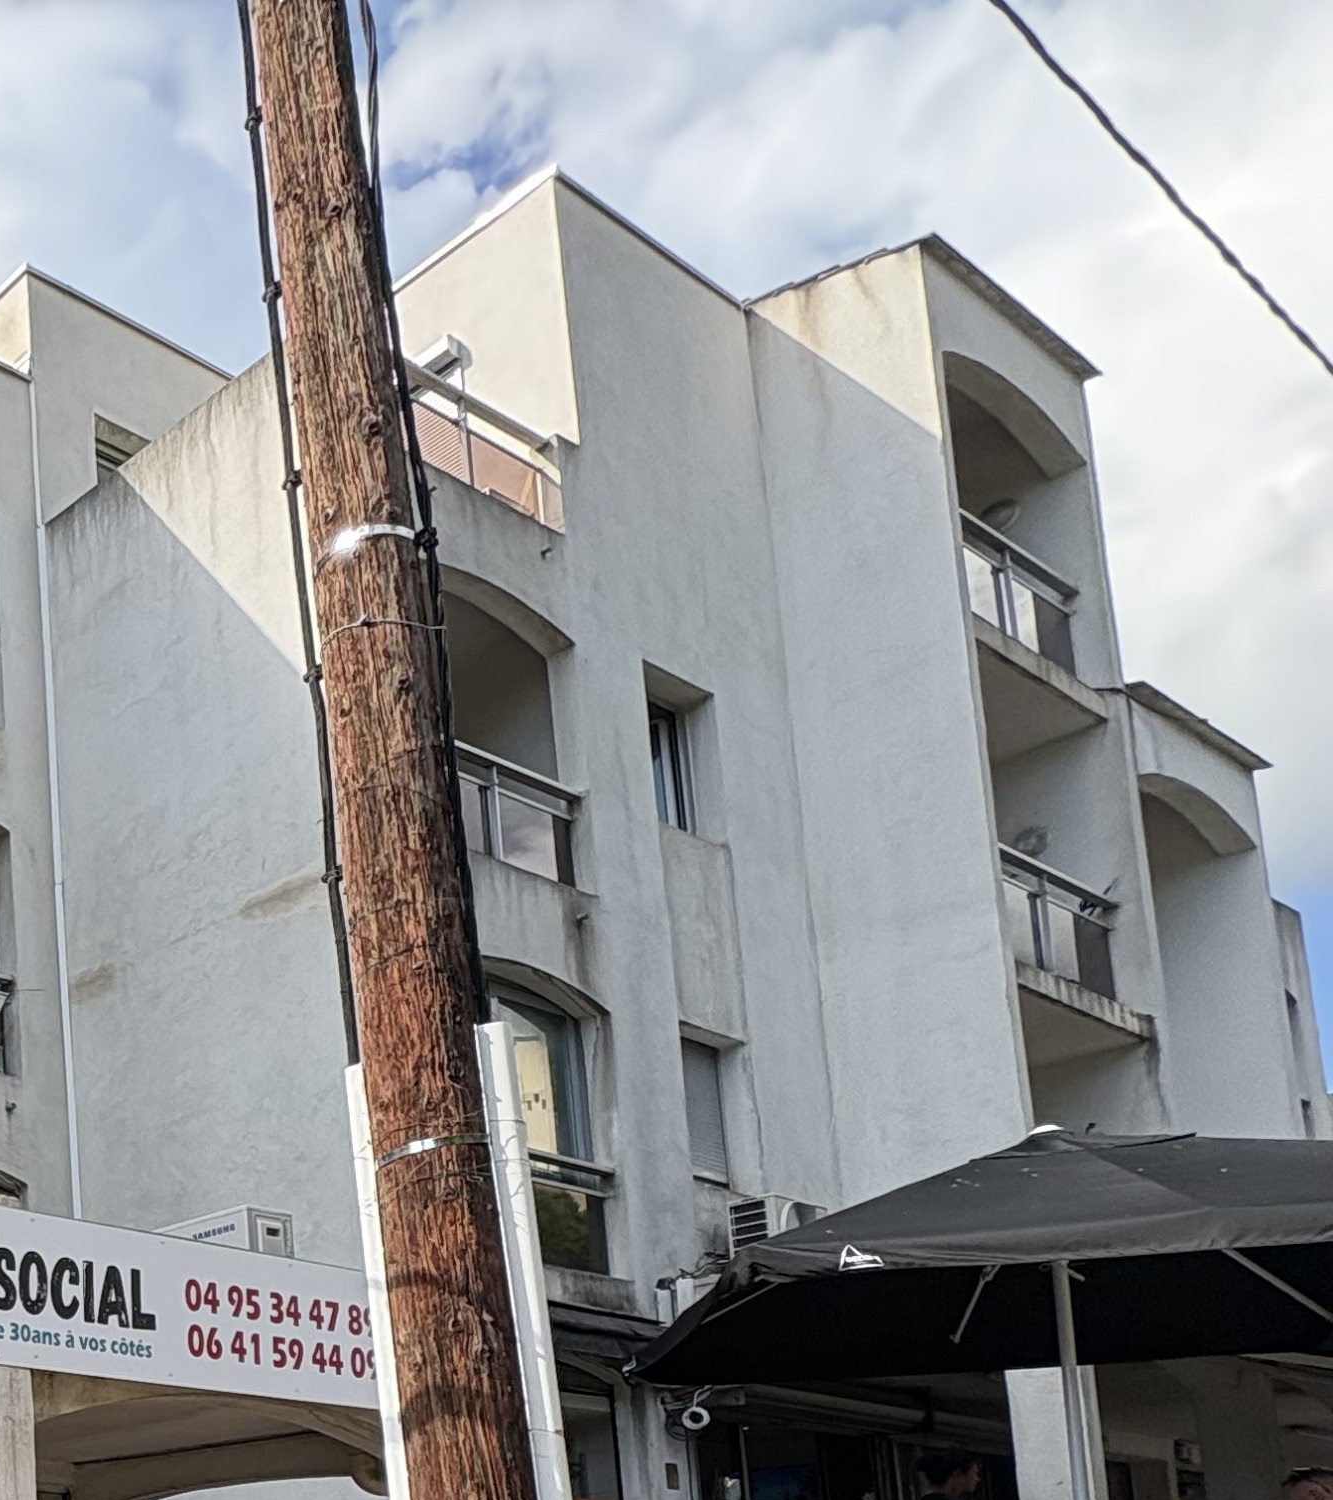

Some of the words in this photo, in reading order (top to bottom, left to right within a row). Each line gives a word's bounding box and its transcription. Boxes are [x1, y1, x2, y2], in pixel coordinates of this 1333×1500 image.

[191, 1223, 236, 1241] SAMSUNG
[185, 1279, 220, 1315] 04
[228, 1285, 261, 1320] 95
[269, 1292, 302, 1327] 34
[309, 1299, 340, 1332] 47
[9, 1321, 59, 1346] 30ans
[63, 1327, 76, 1349] à
[79, 1334, 108, 1352] vos
[111, 1331, 154, 1359] côtés
[187, 1324, 223, 1360] 06
[231, 1330, 261, 1365] 41
[273, 1336, 304, 1370] 59
[312, 1342, 344, 1375] 44
